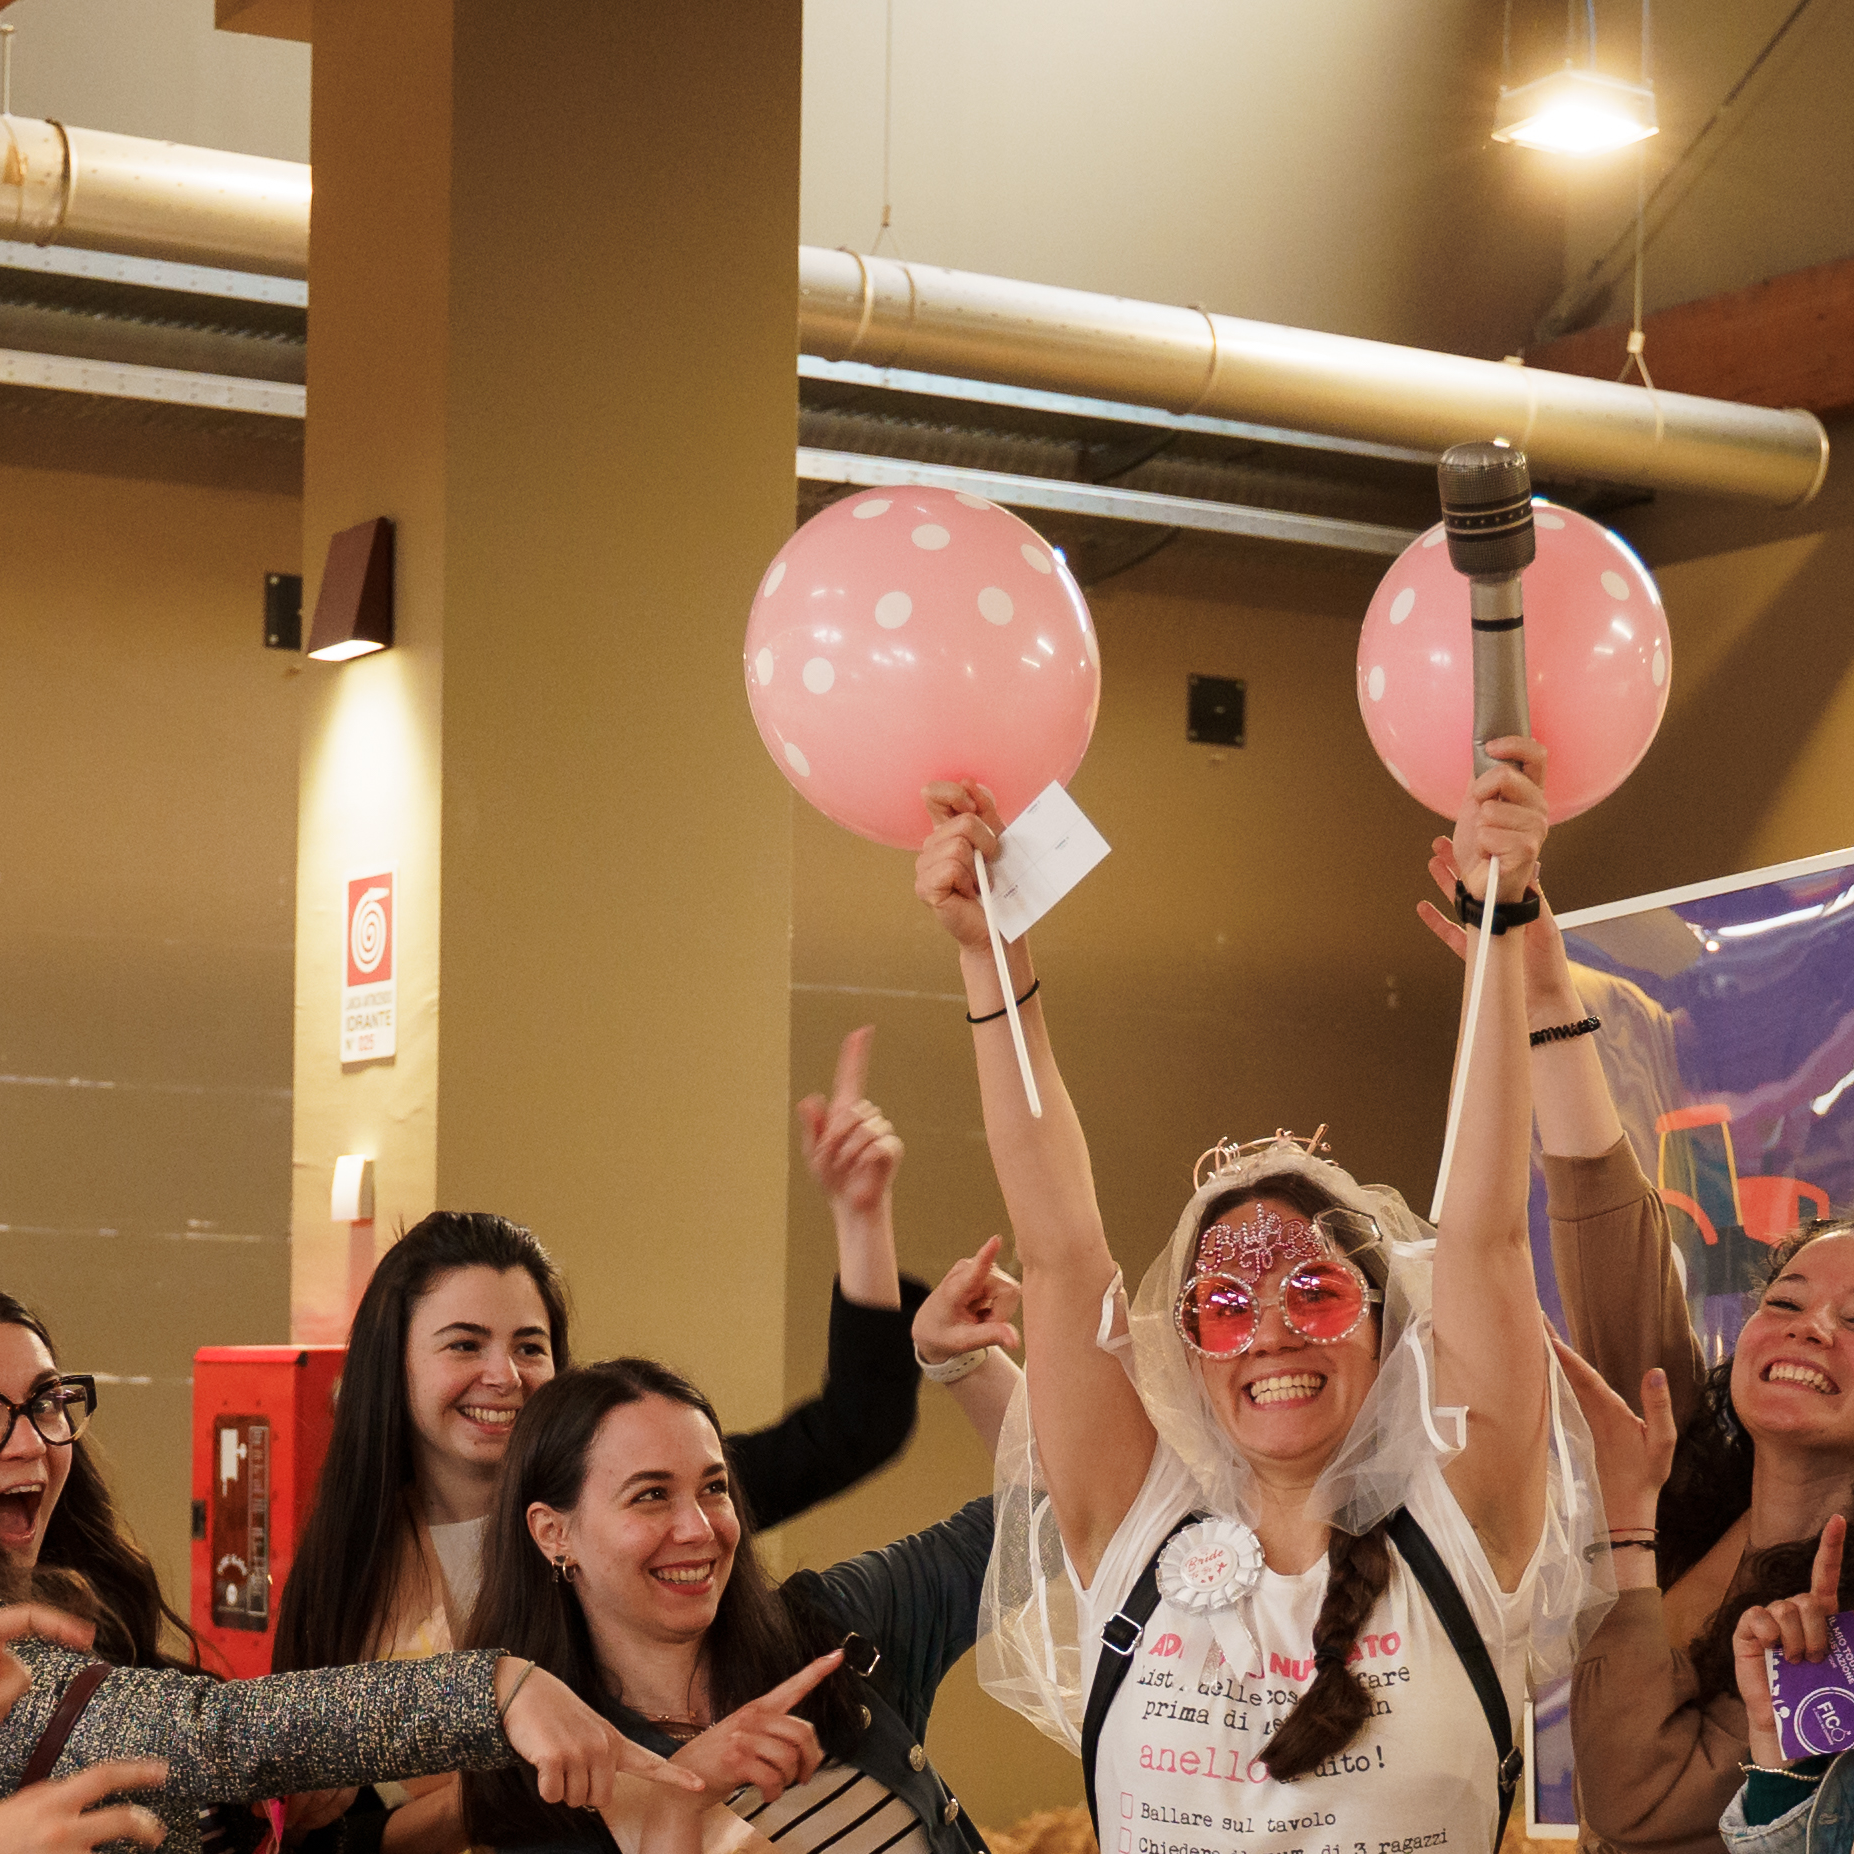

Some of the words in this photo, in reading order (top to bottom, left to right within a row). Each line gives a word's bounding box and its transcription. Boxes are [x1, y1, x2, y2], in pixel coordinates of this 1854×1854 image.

[1832, 1625, 1847, 1647] MIO
[1142, 1699, 1210, 1725] prima
[1223, 1709, 1250, 1732] di
[1139, 1744, 1272, 1785] anello
[1140, 1803, 1213, 1828] Ballare
[1222, 1817, 1255, 1833] sul
[1267, 1811, 1337, 1833] tavolo
